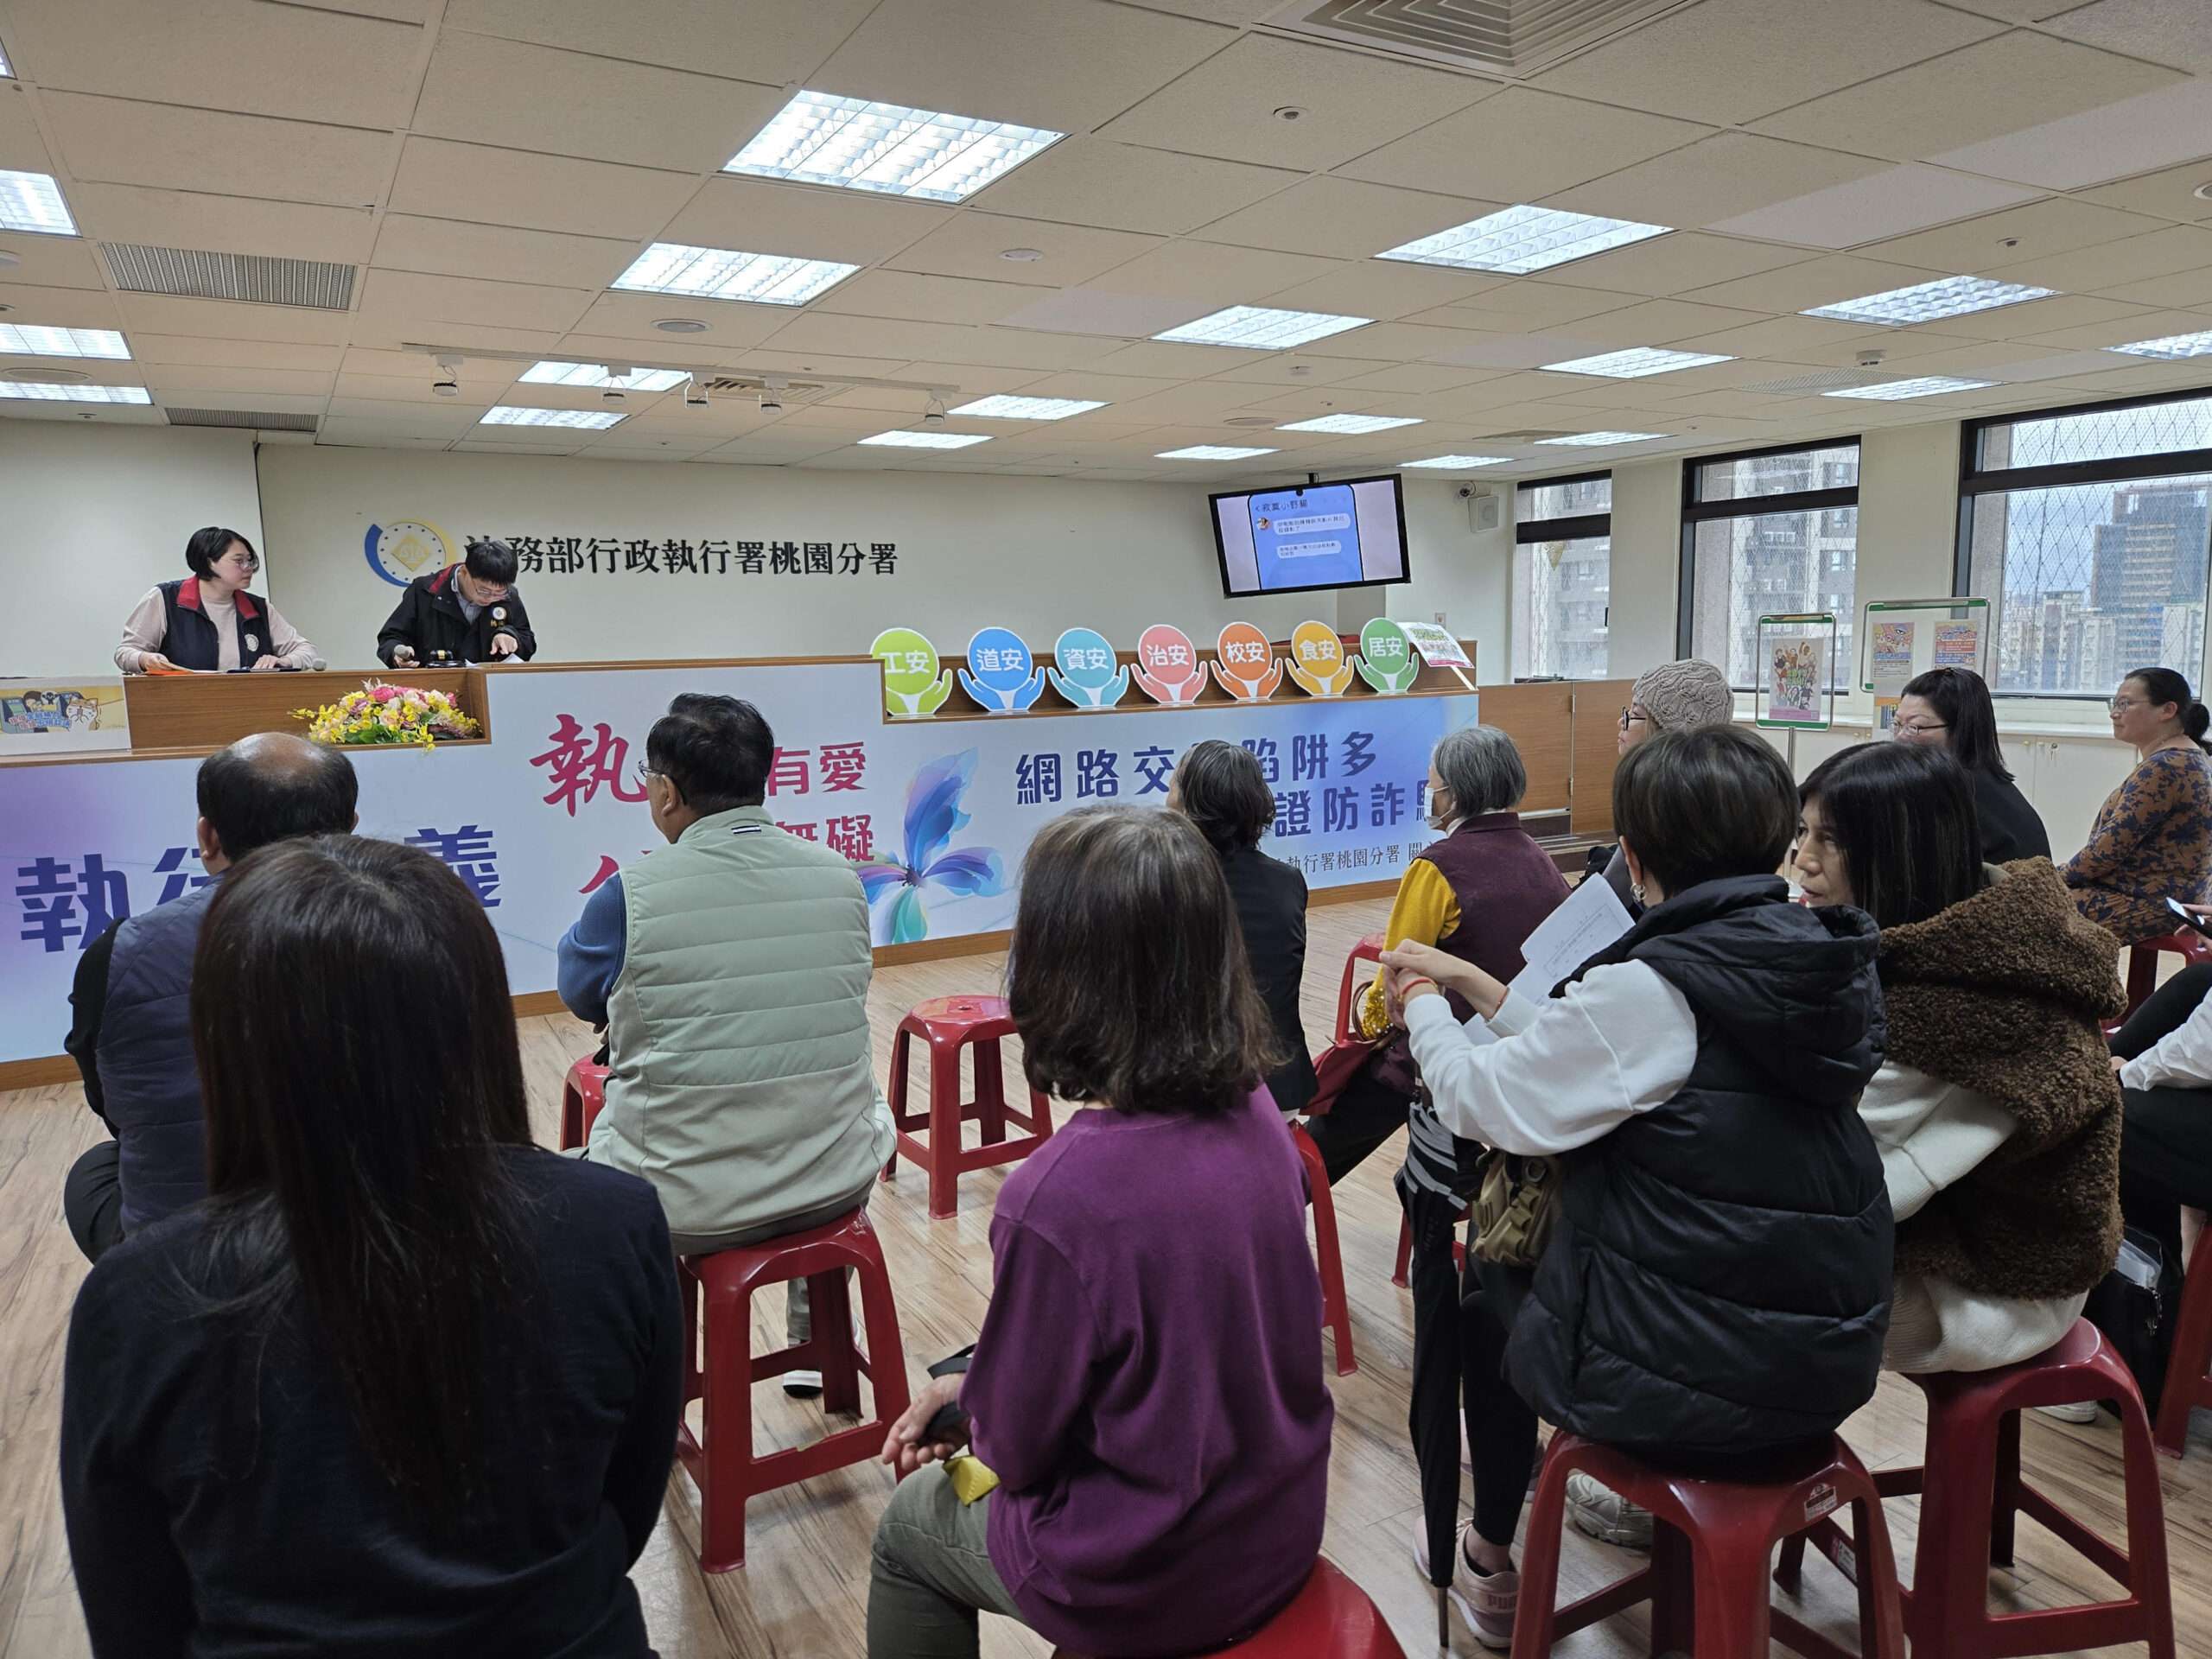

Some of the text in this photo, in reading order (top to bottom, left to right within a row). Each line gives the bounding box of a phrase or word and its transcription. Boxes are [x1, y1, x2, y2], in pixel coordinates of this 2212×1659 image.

[464, 535, 898, 575] 務部行政執行署桃園分署
[1146, 644, 1189, 667] 治安
[1225, 640, 1266, 664] 校安
[1299, 638, 1338, 661] 食安
[1368, 635, 1404, 658] 居安
[880, 650, 930, 674] 工安
[976, 648, 1024, 672] 道安
[1063, 648, 1108, 670] 資安
[1016, 731, 1376, 804] 網路交陷阱多
